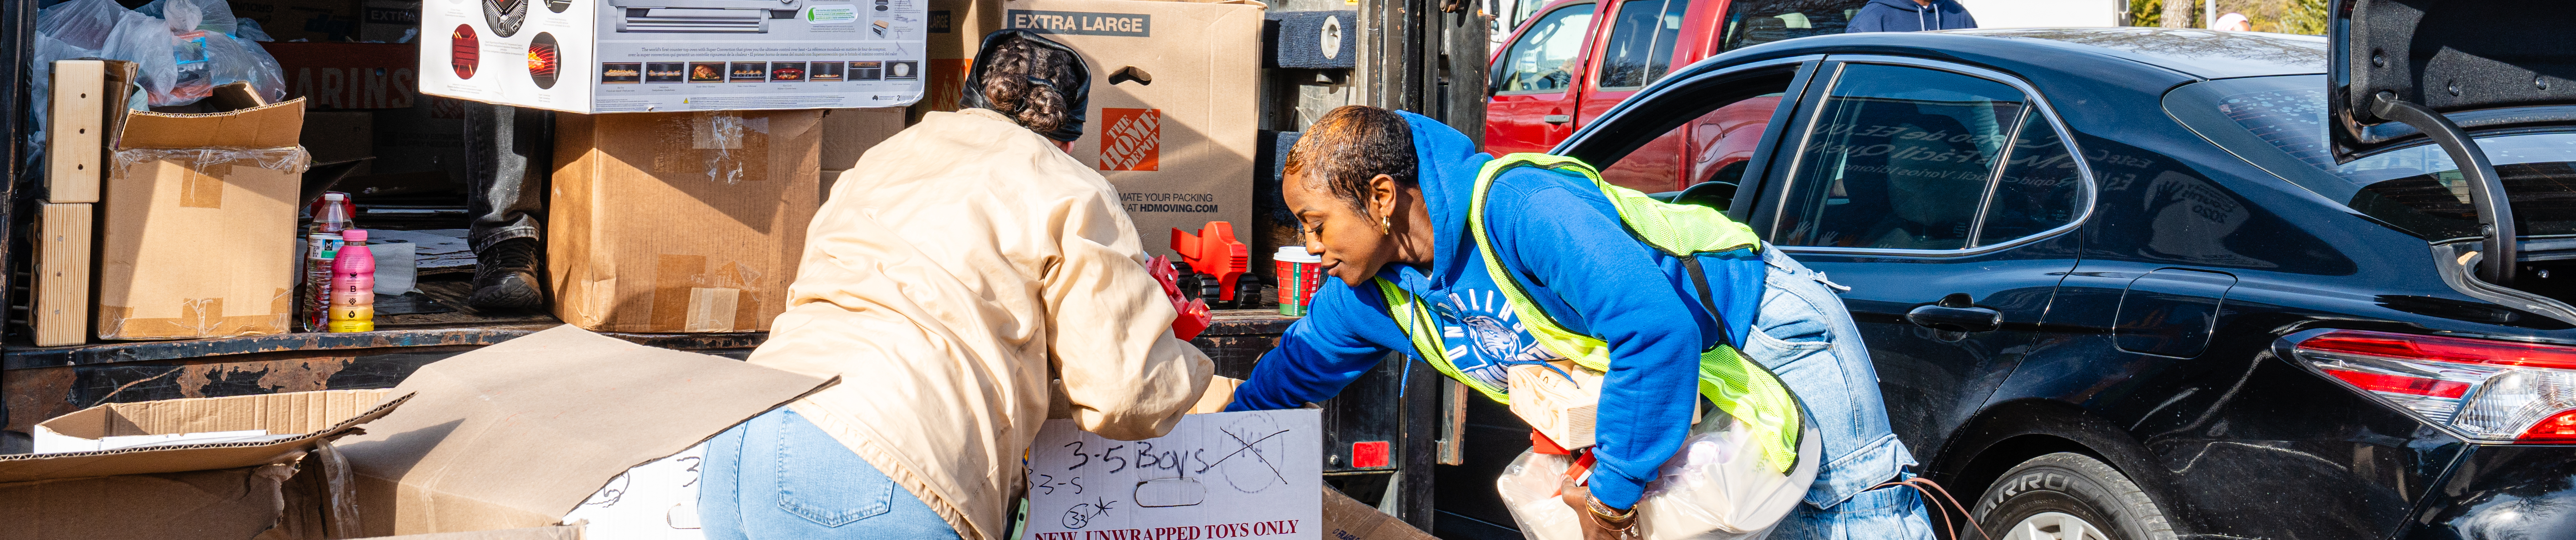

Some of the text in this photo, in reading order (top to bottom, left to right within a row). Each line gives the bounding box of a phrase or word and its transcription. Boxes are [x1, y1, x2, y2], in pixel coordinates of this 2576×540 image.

[371, 10, 416, 22] EXTRA
[1015, 14, 1143, 32] EXTRA LARGE
[283, 67, 413, 109] ARINS
[1106, 114, 1132, 139] THE
[1100, 108, 1160, 171] HOME
[1123, 132, 1160, 171] DEPOT
[1127, 204, 1138, 212] AT
[1140, 204, 1218, 213] HDMOVING.COM
[1145, 193, 1170, 202] YOUR
[1173, 193, 1213, 202] PACKING
[1064, 441, 1126, 474] 3-5
[1085, 525, 1201, 540] UNWRAPPED
[1205, 523, 1249, 539] TOYS
[1254, 520, 1299, 536] ONLY
